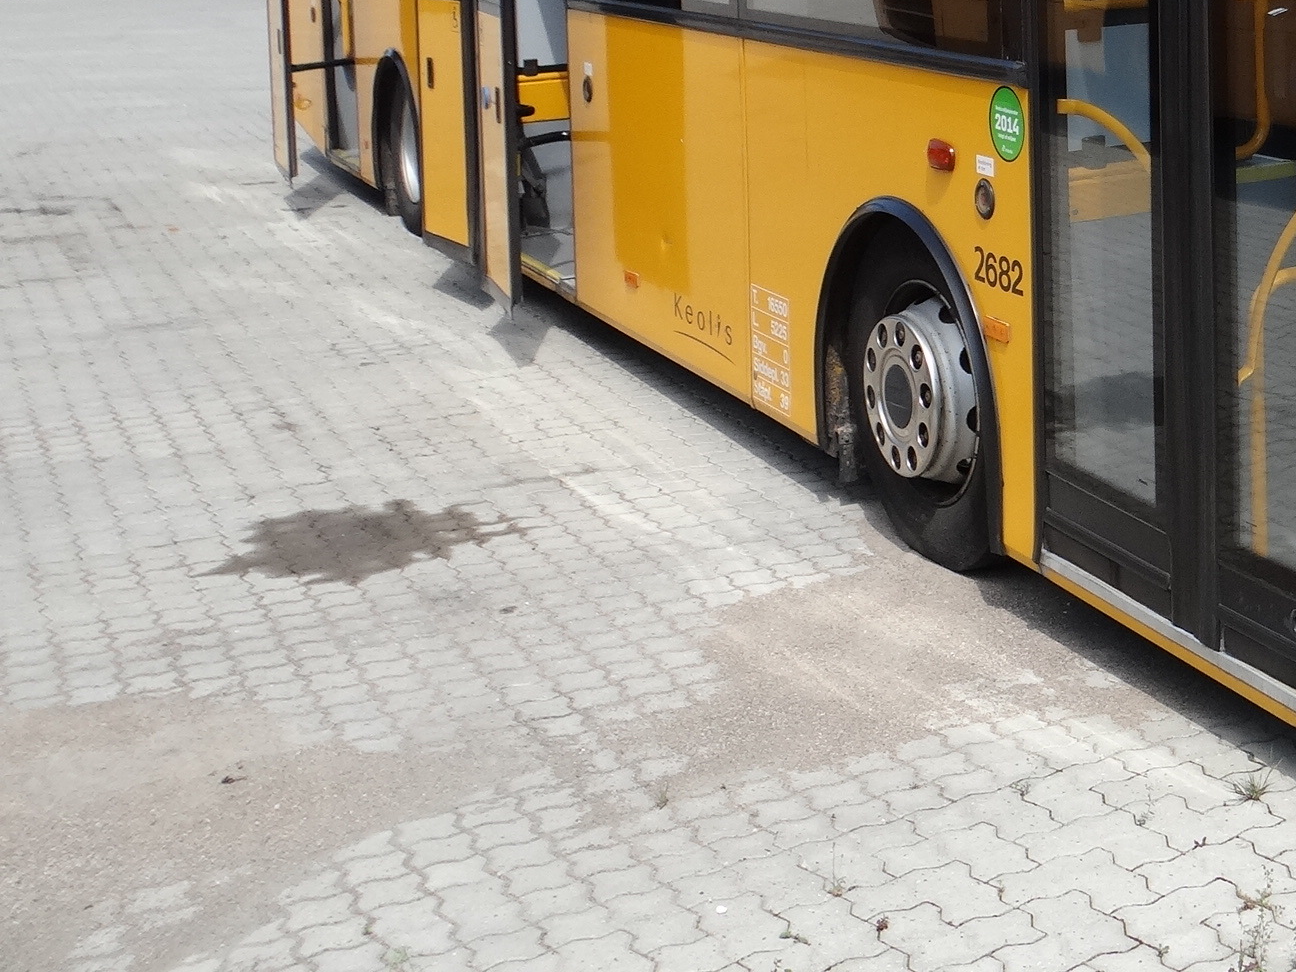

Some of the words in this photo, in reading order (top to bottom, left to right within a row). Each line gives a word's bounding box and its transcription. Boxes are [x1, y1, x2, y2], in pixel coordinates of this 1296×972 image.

[994, 113, 1020, 136] 2014
[974, 245, 1024, 297] 2682
[674, 292, 733, 346] Keolis
[770, 319, 788, 341] 5225
[783, 349, 788, 364] 0
[780, 370, 789, 388] 33
[780, 393, 789, 411] 39
